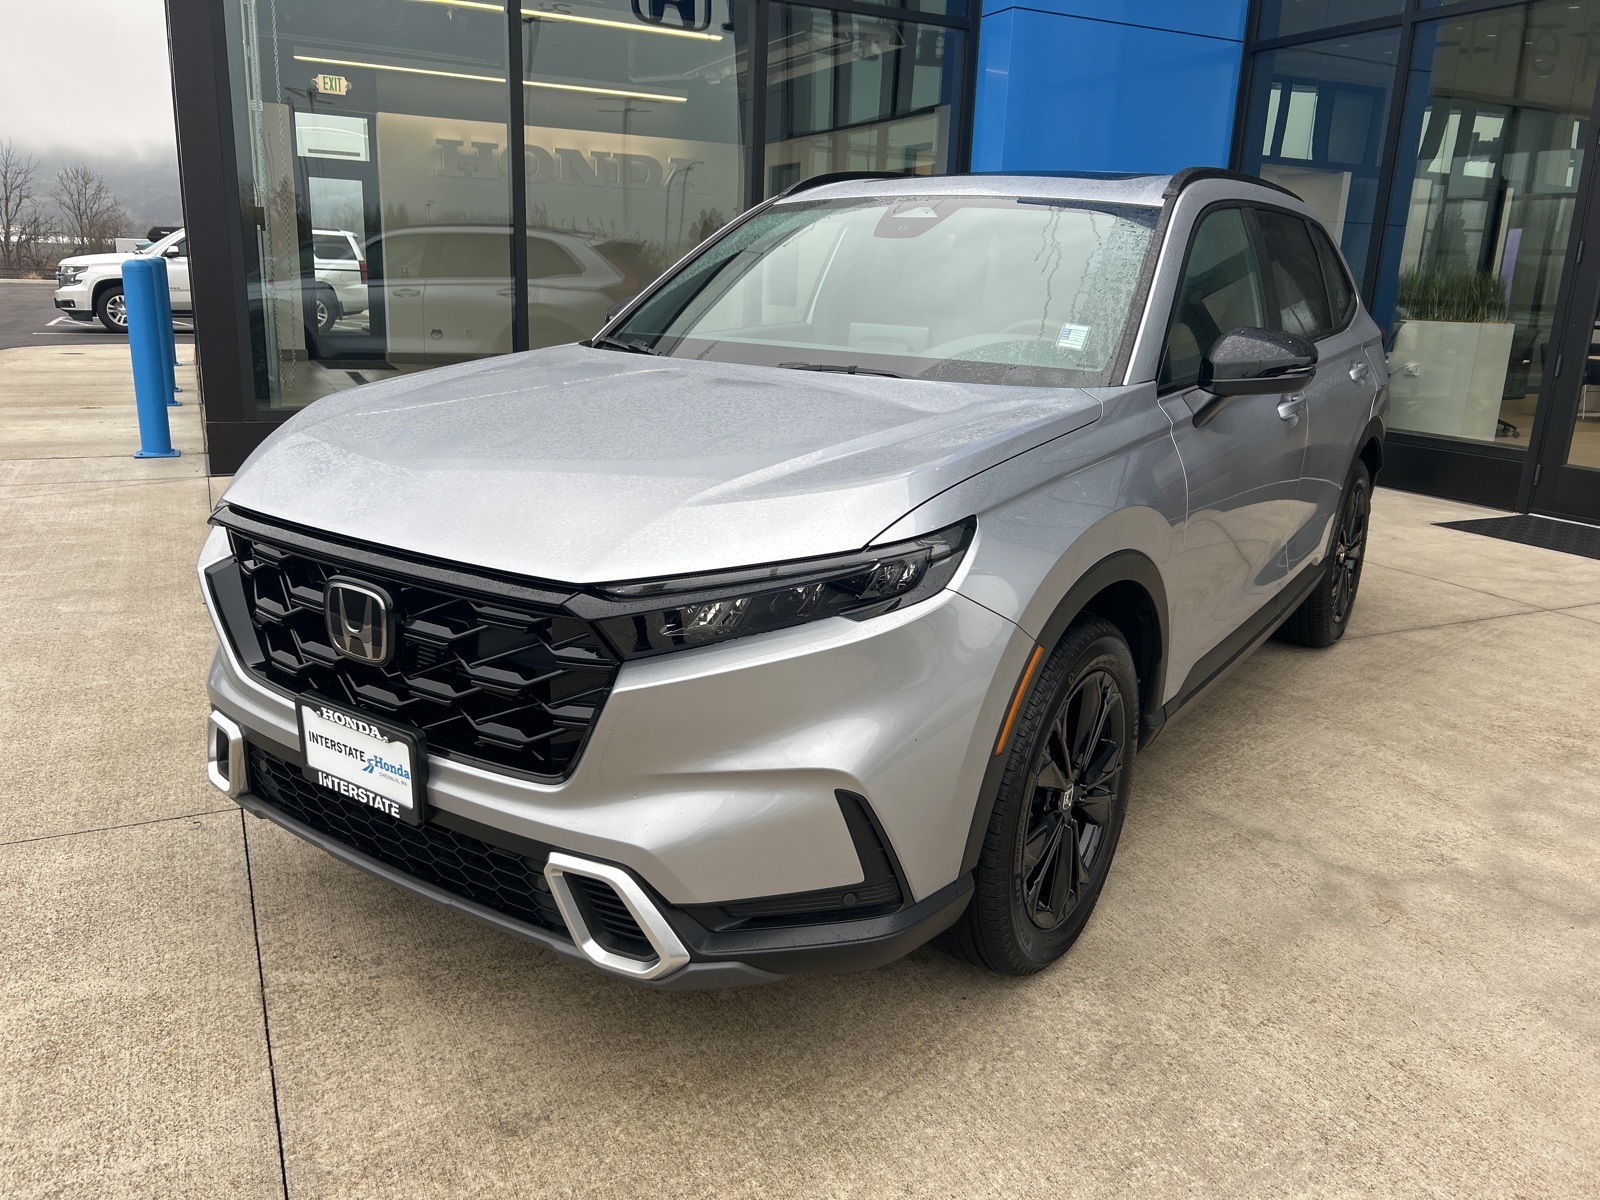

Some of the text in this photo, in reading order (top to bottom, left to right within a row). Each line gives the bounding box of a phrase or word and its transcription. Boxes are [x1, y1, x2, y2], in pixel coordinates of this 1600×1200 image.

[322, 75, 342, 92] EXIT
[435, 138, 712, 195] HONDA
[320, 706, 383, 741] HONDA
[308, 730, 411, 780] INTERSTATE Honda
[318, 771, 400, 819] INTERSTATE
